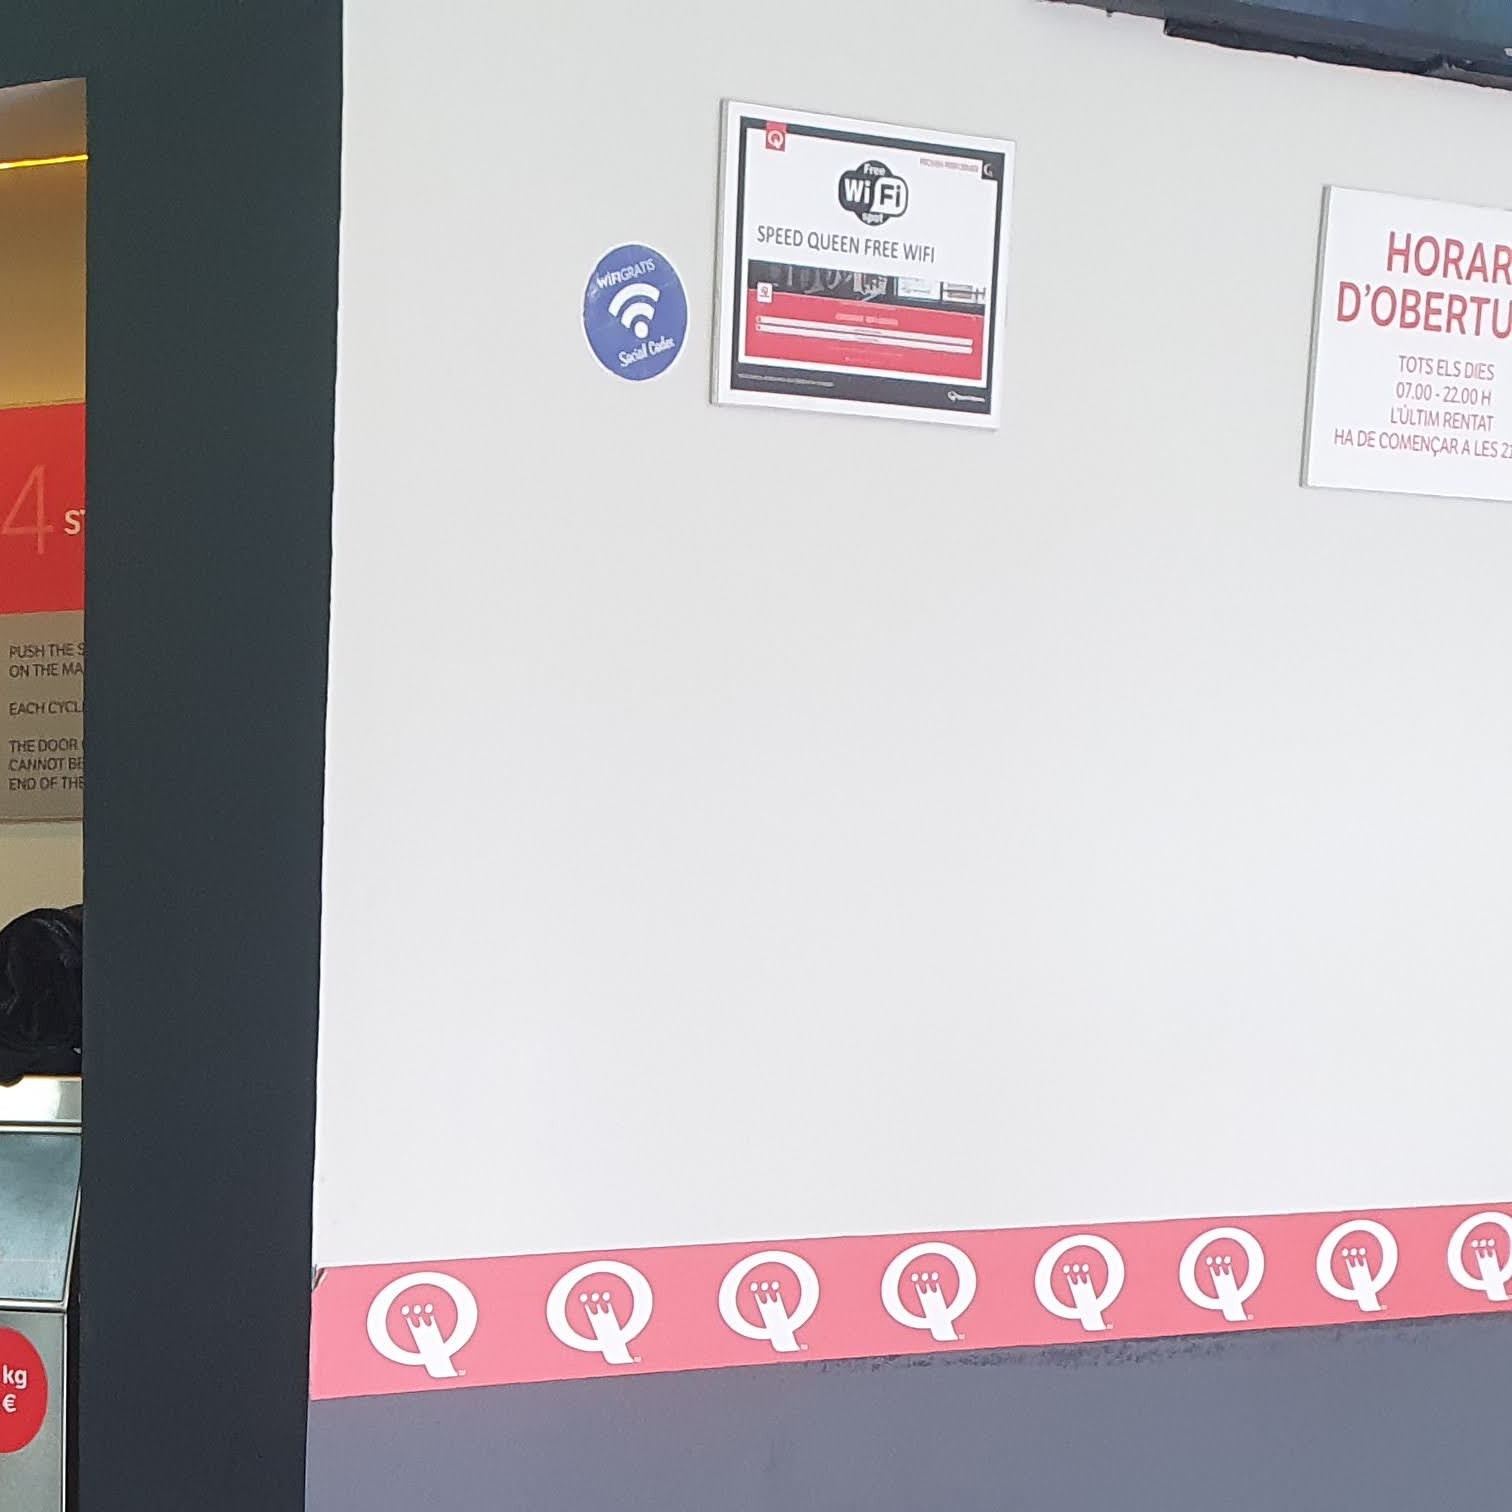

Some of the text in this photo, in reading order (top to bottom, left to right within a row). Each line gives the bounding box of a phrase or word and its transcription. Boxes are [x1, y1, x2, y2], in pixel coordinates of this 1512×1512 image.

[864, 163, 885, 176] Free
[757, 225, 935, 263] SPEED QUEEN FREE WIFI
[1387, 231, 1512, 285] HORAR
[1337, 281, 1512, 339] D'OBERTU
[619, 343, 648, 367] Social
[1399, 355, 1495, 381] TOTS ELS DIES
[1396, 381, 1492, 406] 07.00 22.00 H
[1443, 411, 1494, 432] RENTAT
[1334, 428, 1353, 446] HA
[1357, 430, 1376, 448] DE
[1379, 432, 1458, 457] COMENÇAR
[1461, 441, 1471, 455] A
[1474, 440, 1498, 458] LES
[1, 464, 86, 555] 4 S
[9, 643, 73, 658] PUSH THE
[9, 664, 29, 678] ON
[32, 663, 59, 677] THE
[9, 700, 84, 716] EACH CYCL
[9, 737, 77, 753] THE DOOR
[9, 757, 65, 772] CANNOT
[9, 777, 36, 791] END
[39, 776, 59, 790] OF
[366, 1271, 479, 1378] Q
[545, 1260, 653, 1364] Q
[718, 1250, 820, 1352] Q
[881, 1241, 977, 1341] Q
[1034, 1234, 1125, 1330] Q
[1179, 1226, 1265, 1321] Q
[1316, 1219, 1399, 1312] Q
[3, 1364, 27, 1389] kg
